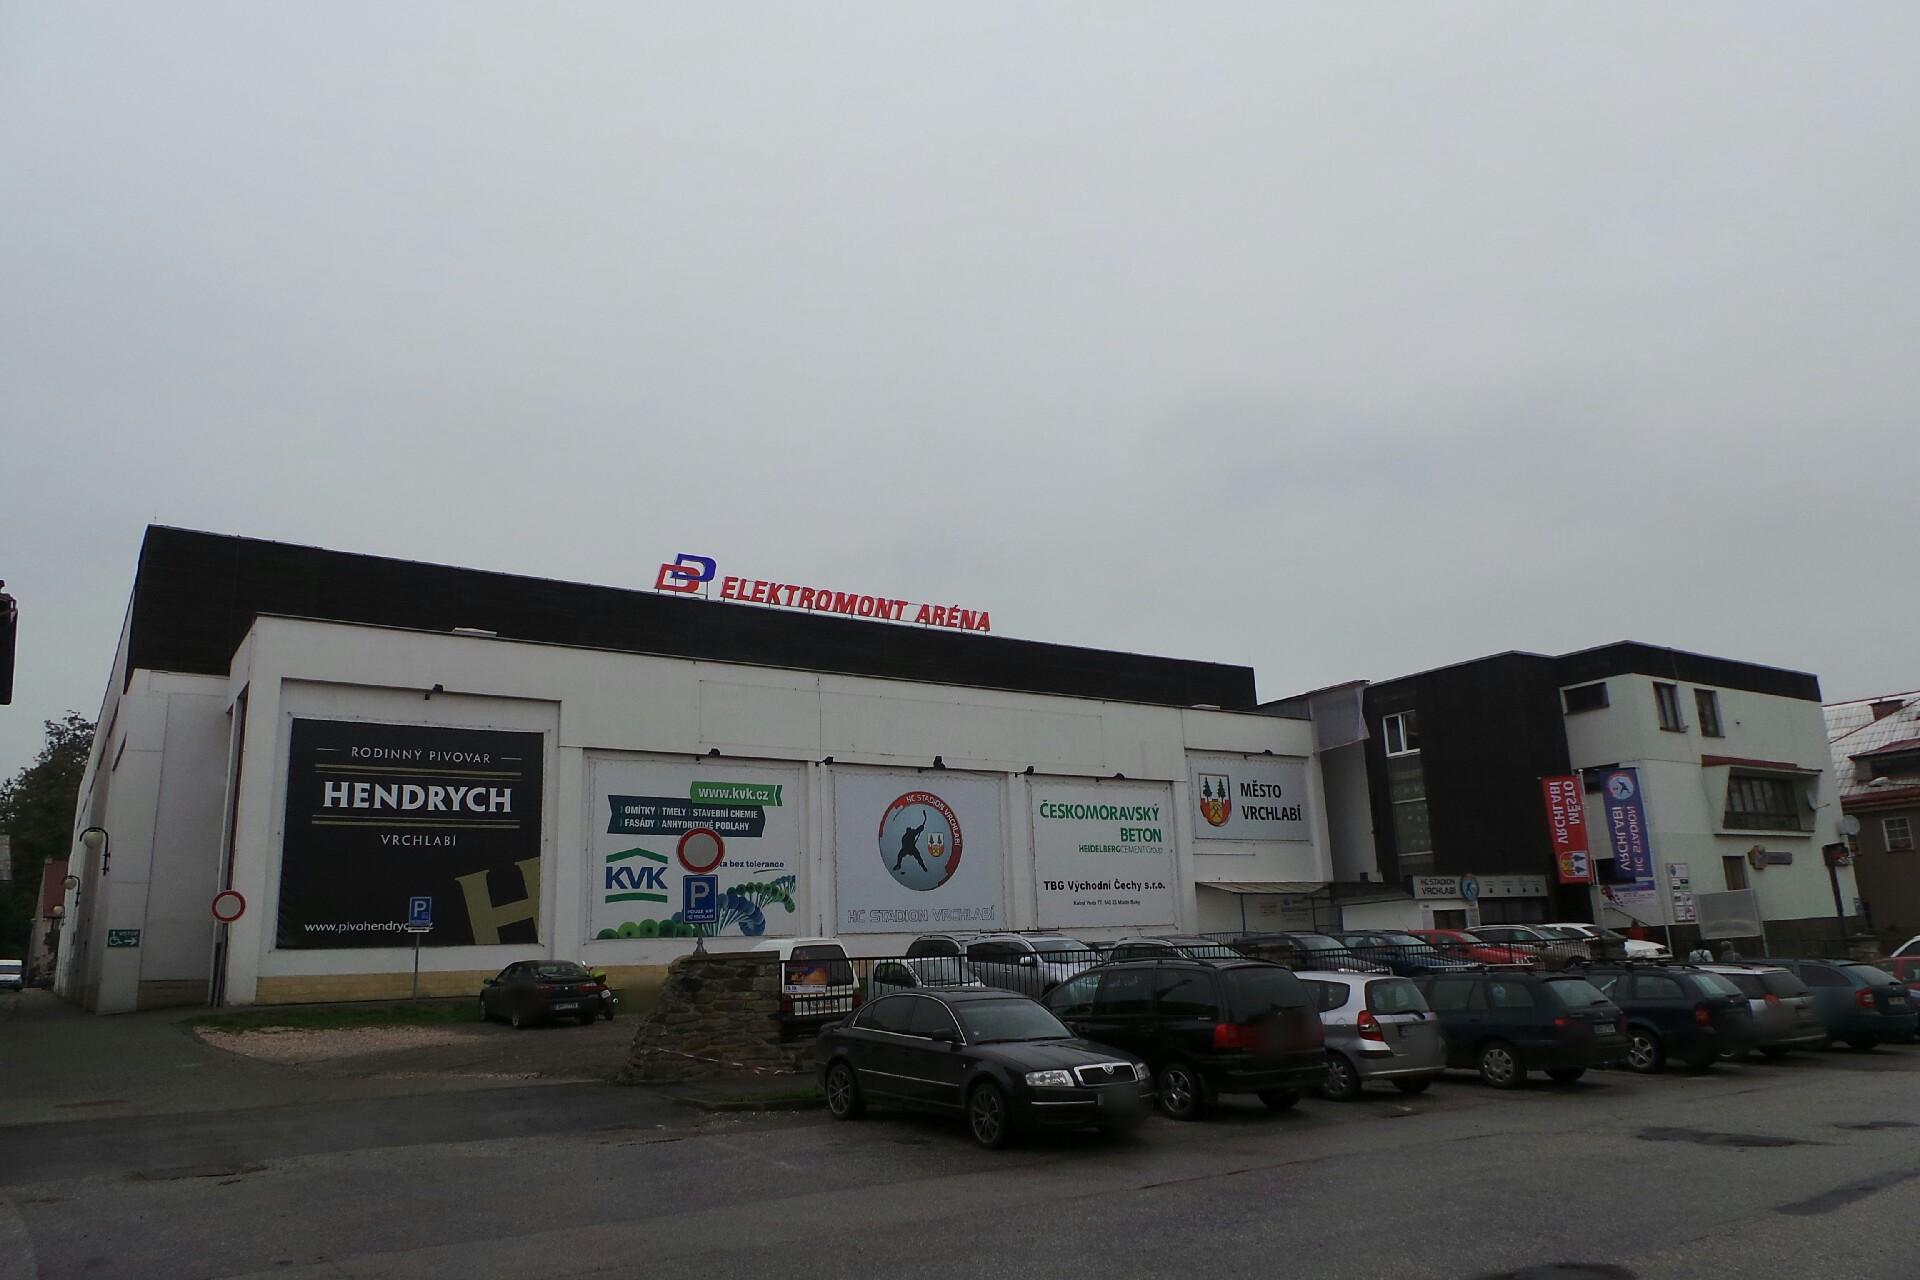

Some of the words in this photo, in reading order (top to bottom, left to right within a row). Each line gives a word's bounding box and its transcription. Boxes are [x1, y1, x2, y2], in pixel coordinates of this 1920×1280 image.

[720, 576, 908, 620] ELEKTROMONT
[914, 603, 991, 632] ARÉNA
[351, 746, 422, 761] RODINNÝ
[429, 750, 491, 764] PIVOVAR
[322, 780, 513, 813] HENDRYCH
[698, 786, 769, 801] www.kvk.cz
[1240, 780, 1282, 799] MĚSTO
[624, 804, 656, 815] OMÍTKY
[662, 807, 686, 817] TMELY
[692, 807, 729, 818] STAVEBNÍ
[730, 809, 759, 819] CHEMIE
[1039, 799, 1160, 821] ČESKOMORAVSKÝ
[1241, 804, 1302, 821] VRCHLABÍ
[624, 818, 655, 829] FASÁDY
[661, 819, 714, 830] ANHYDRITOVÉ
[715, 822, 750, 831] PODLAHY
[906, 795, 916, 803] HC
[916, 794, 945, 812] STADION
[944, 808, 962, 846] VRCHLABÍ
[380, 833, 457, 847] VRCHLABÍ
[1120, 827, 1162, 843] BETON
[729, 859, 743, 868] bez
[746, 859, 785, 869] tolerance
[605, 866, 668, 889] KVK
[1043, 880, 1065, 891] TBG
[1067, 880, 1111, 893] Východní
[1113, 878, 1142, 892] Čechy
[1144, 882, 1166, 890] s.r.o.
[690, 881, 710, 908] P
[413, 900, 427, 918] P
[848, 909, 866, 924] HC
[869, 909, 929, 924] STADION
[932, 904, 996, 921] VRCHLABÍ
